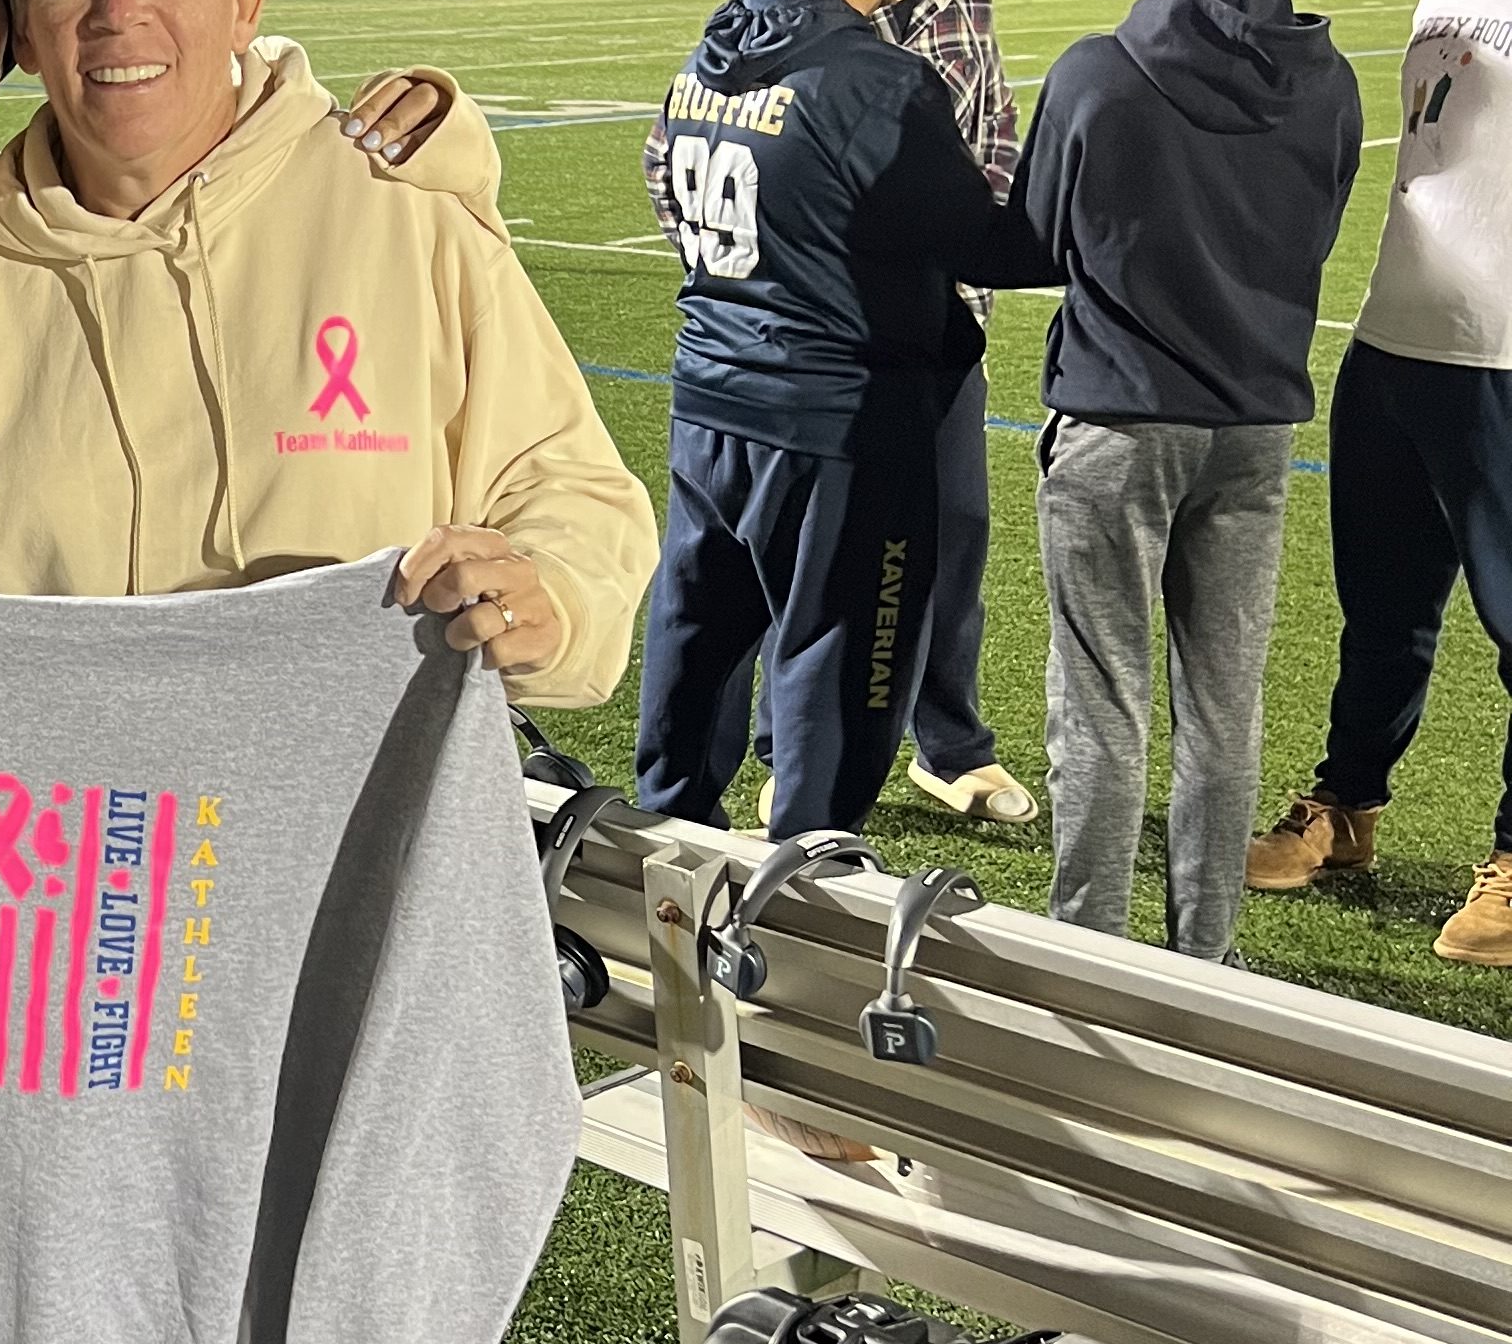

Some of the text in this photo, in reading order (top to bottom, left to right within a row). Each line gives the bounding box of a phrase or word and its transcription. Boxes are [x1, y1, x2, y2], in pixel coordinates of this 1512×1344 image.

[672, 135, 761, 279] 99
[274, 429, 410, 455] Team Kathleen
[867, 539, 907, 708] XAVERIAN
[88, 789, 147, 1090] LIVE LOVE FIGHT
[163, 795, 222, 1090] KATHLEEN
